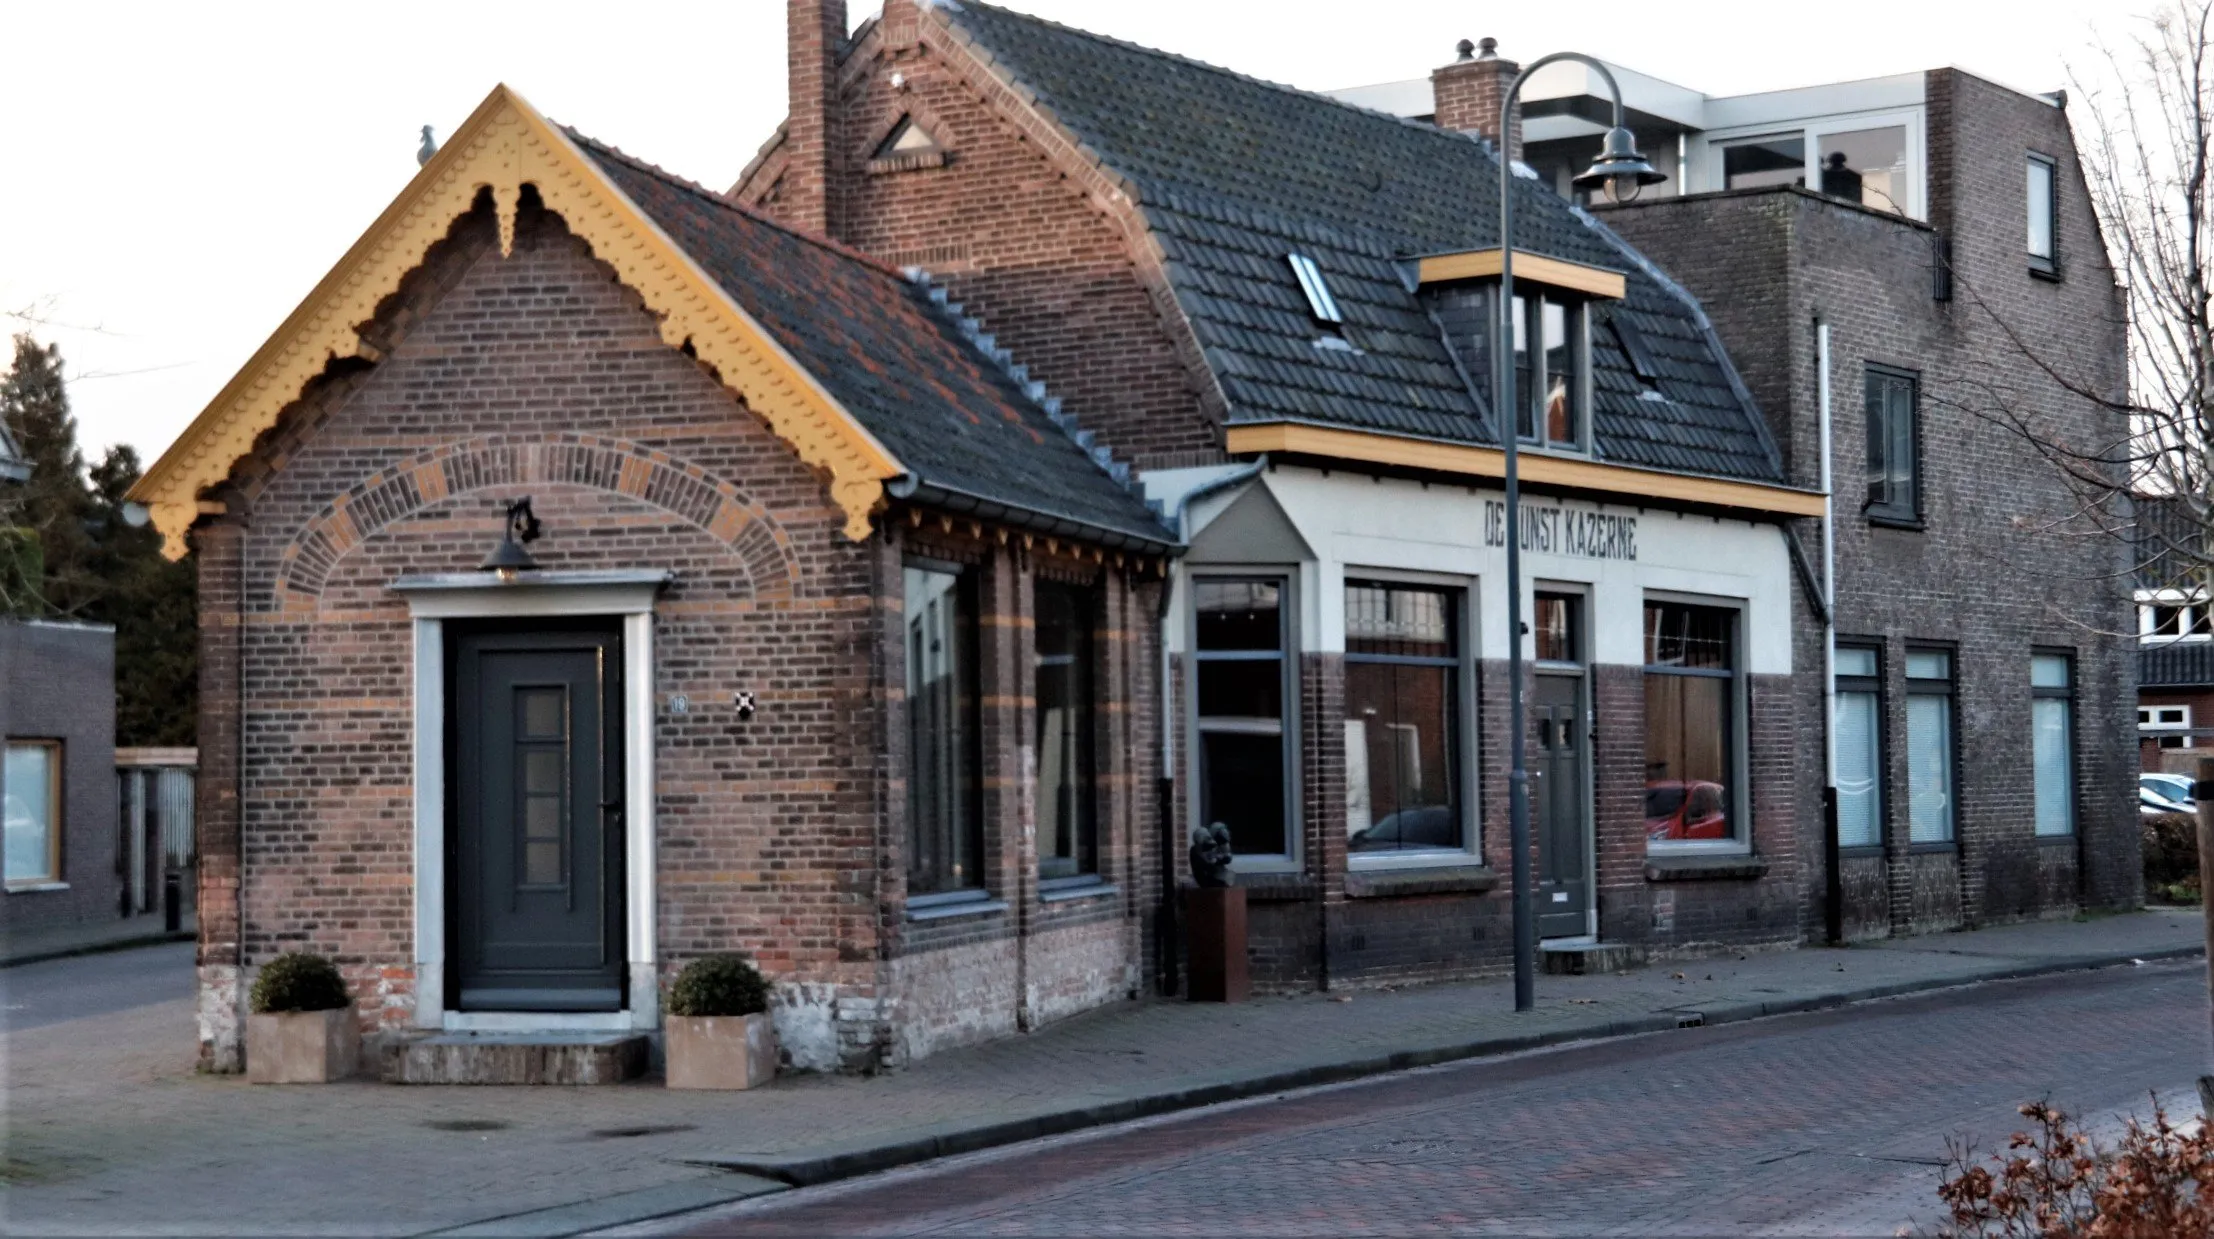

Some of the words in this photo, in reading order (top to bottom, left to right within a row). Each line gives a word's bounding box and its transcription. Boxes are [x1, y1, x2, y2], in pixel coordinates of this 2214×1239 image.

[1485, 500, 1504, 547] DE
[1516, 504, 1560, 553] UNST
[1565, 509, 1637, 561] KAZERNE
